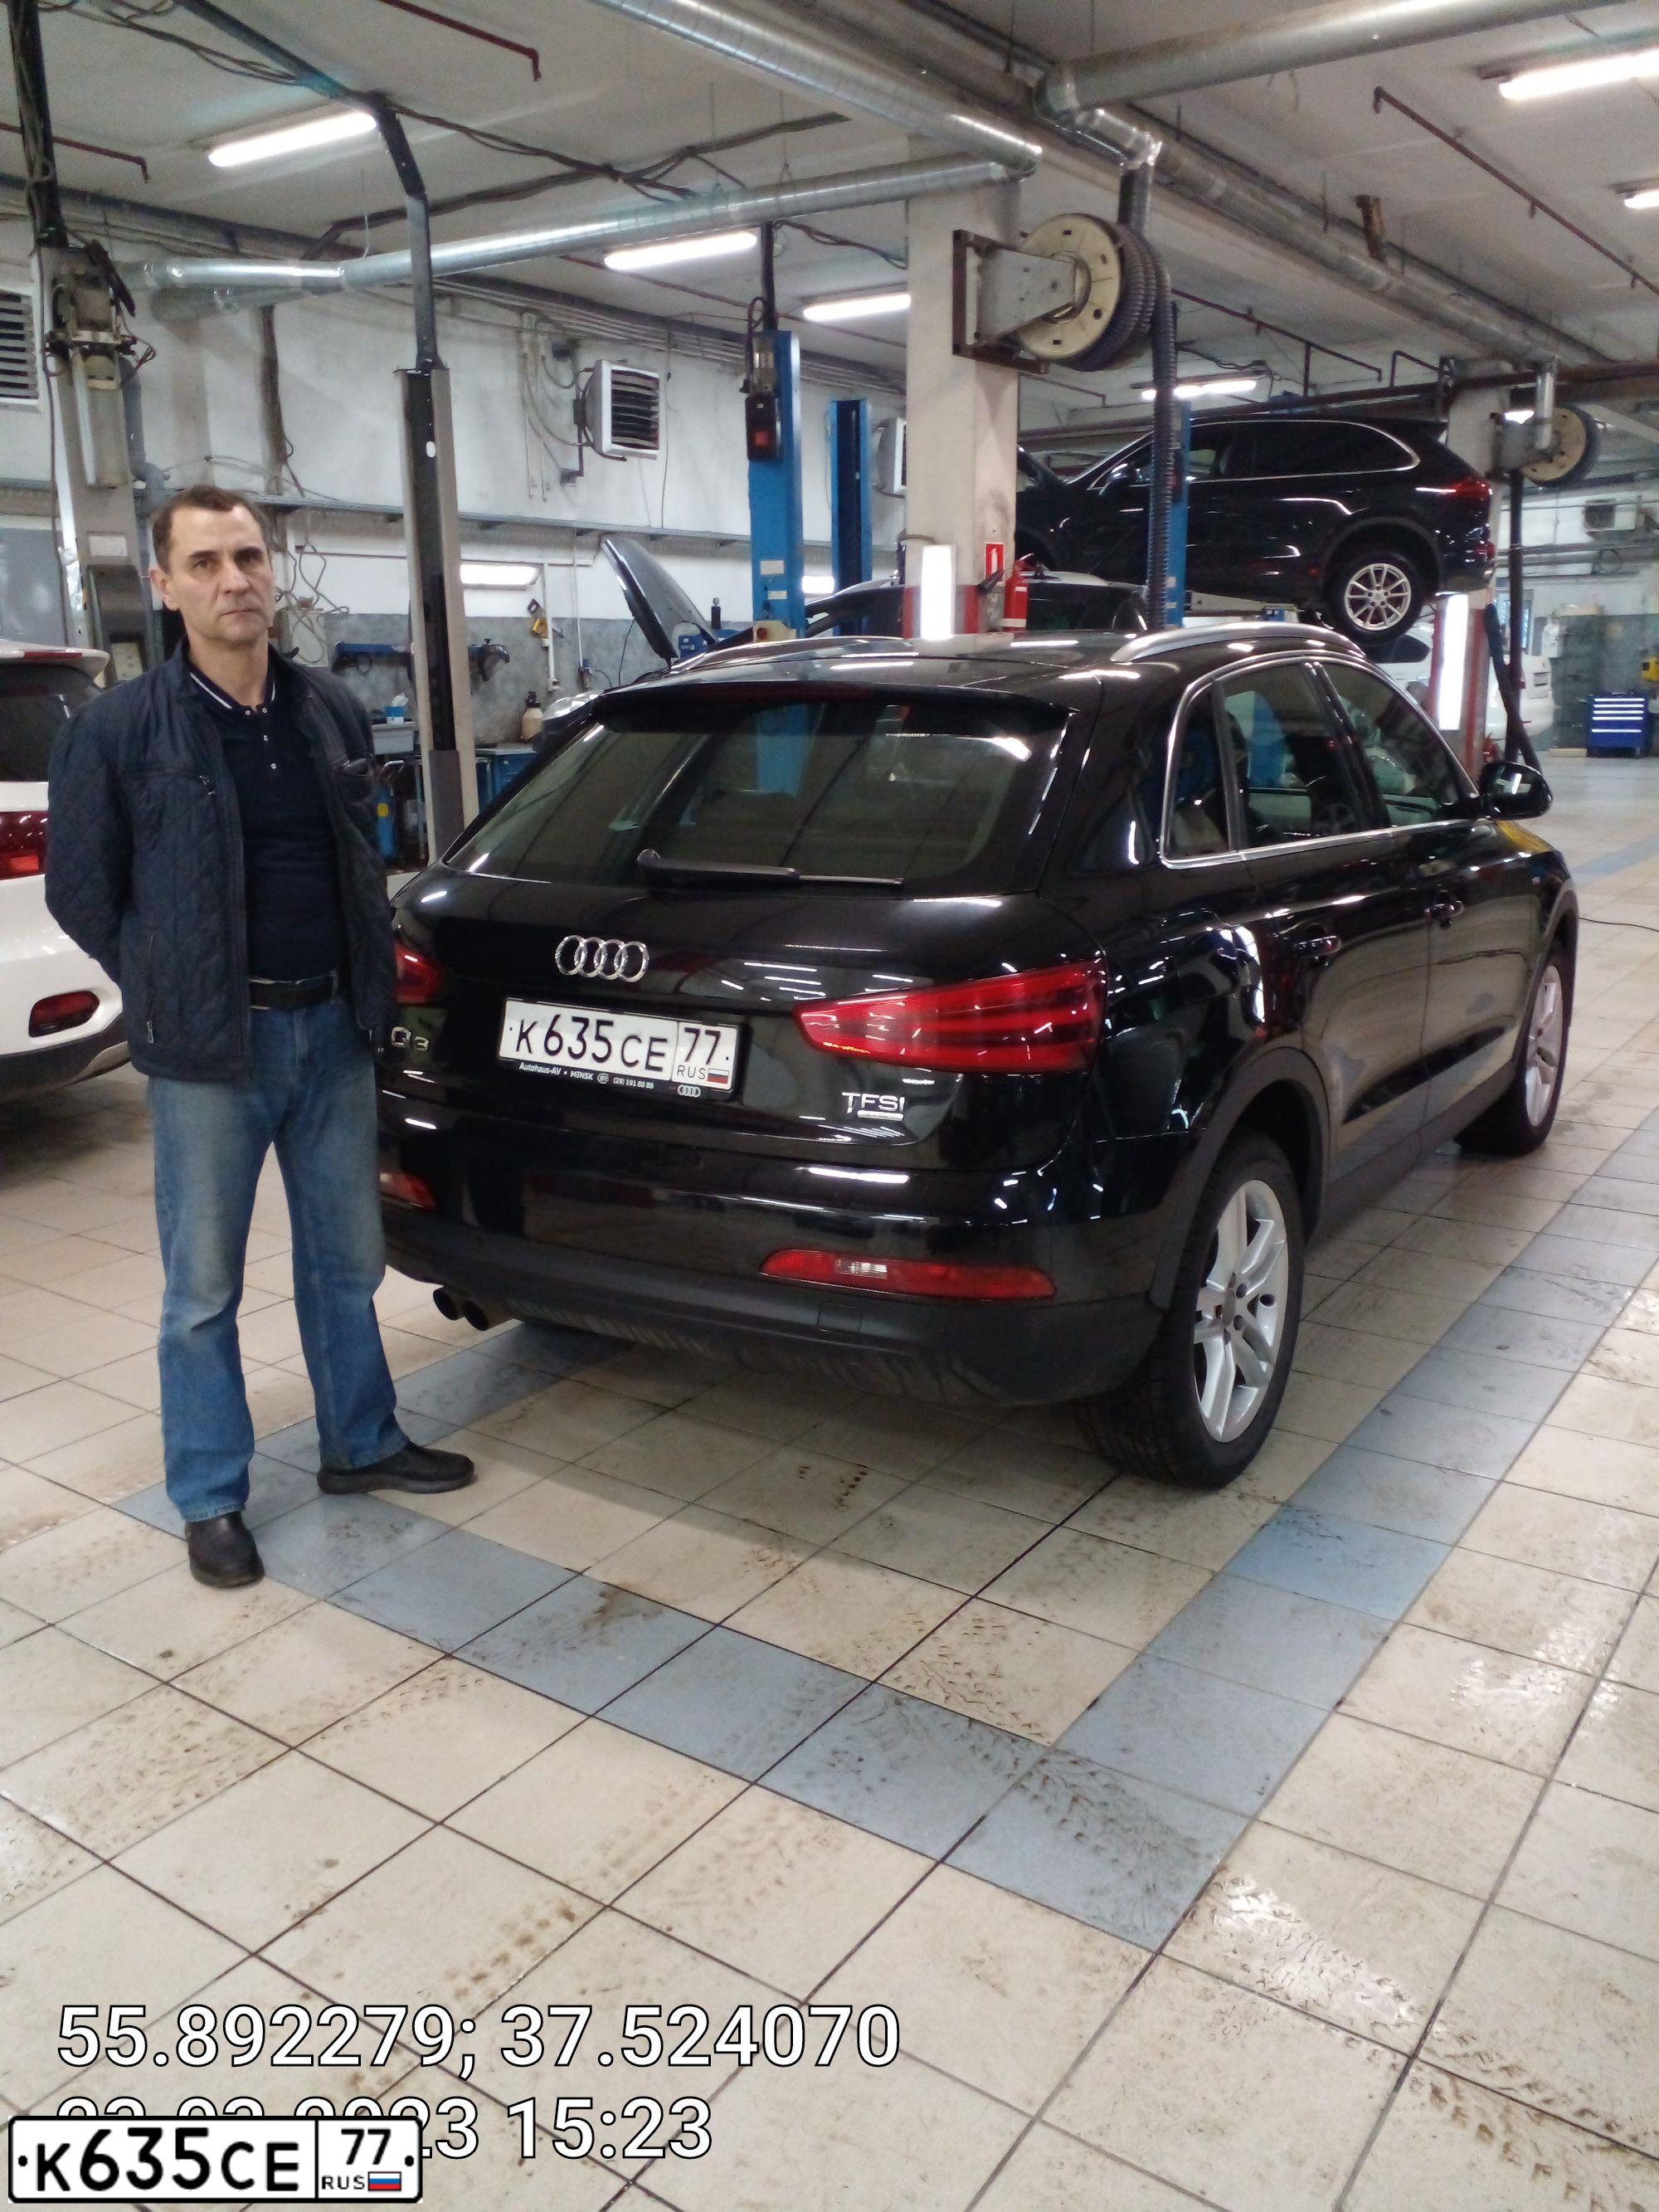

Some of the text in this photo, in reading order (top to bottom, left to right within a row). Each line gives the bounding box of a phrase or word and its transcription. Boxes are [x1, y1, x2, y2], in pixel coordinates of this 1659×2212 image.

[391, 1026, 430, 1051] Q3
[684, 1026, 721, 1065] 77
[518, 1062, 562, 1076] Autohaus-AV
[570, 1070, 594, 1081] MINSK
[676, 1065, 707, 1080] RUS
[841, 1092, 905, 1113] TFSI
